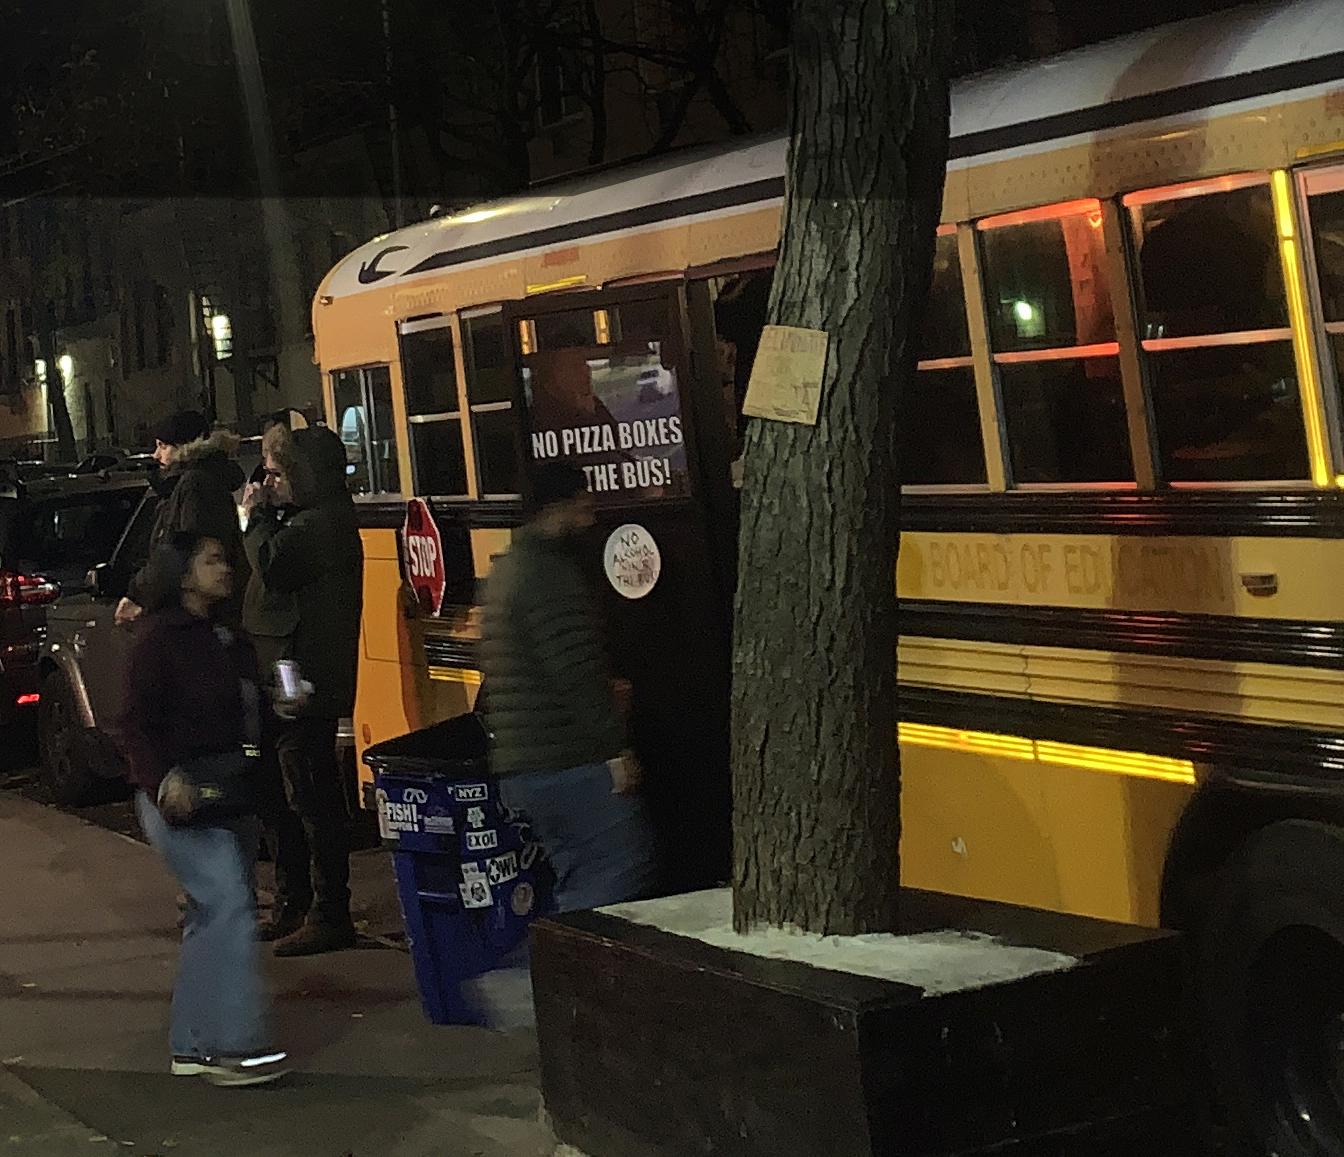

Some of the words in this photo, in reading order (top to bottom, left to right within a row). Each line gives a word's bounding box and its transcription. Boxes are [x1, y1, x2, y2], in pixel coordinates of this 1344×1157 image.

[532, 430, 559, 459] NO
[562, 424, 616, 456] PIZZA
[618, 416, 684, 450] BOXES
[582, 463, 619, 492] THE
[622, 458, 672, 489] BUS!
[408, 535, 436, 577] STOP
[620, 532, 640, 548] NO
[1019, 544, 1052, 593] OF
